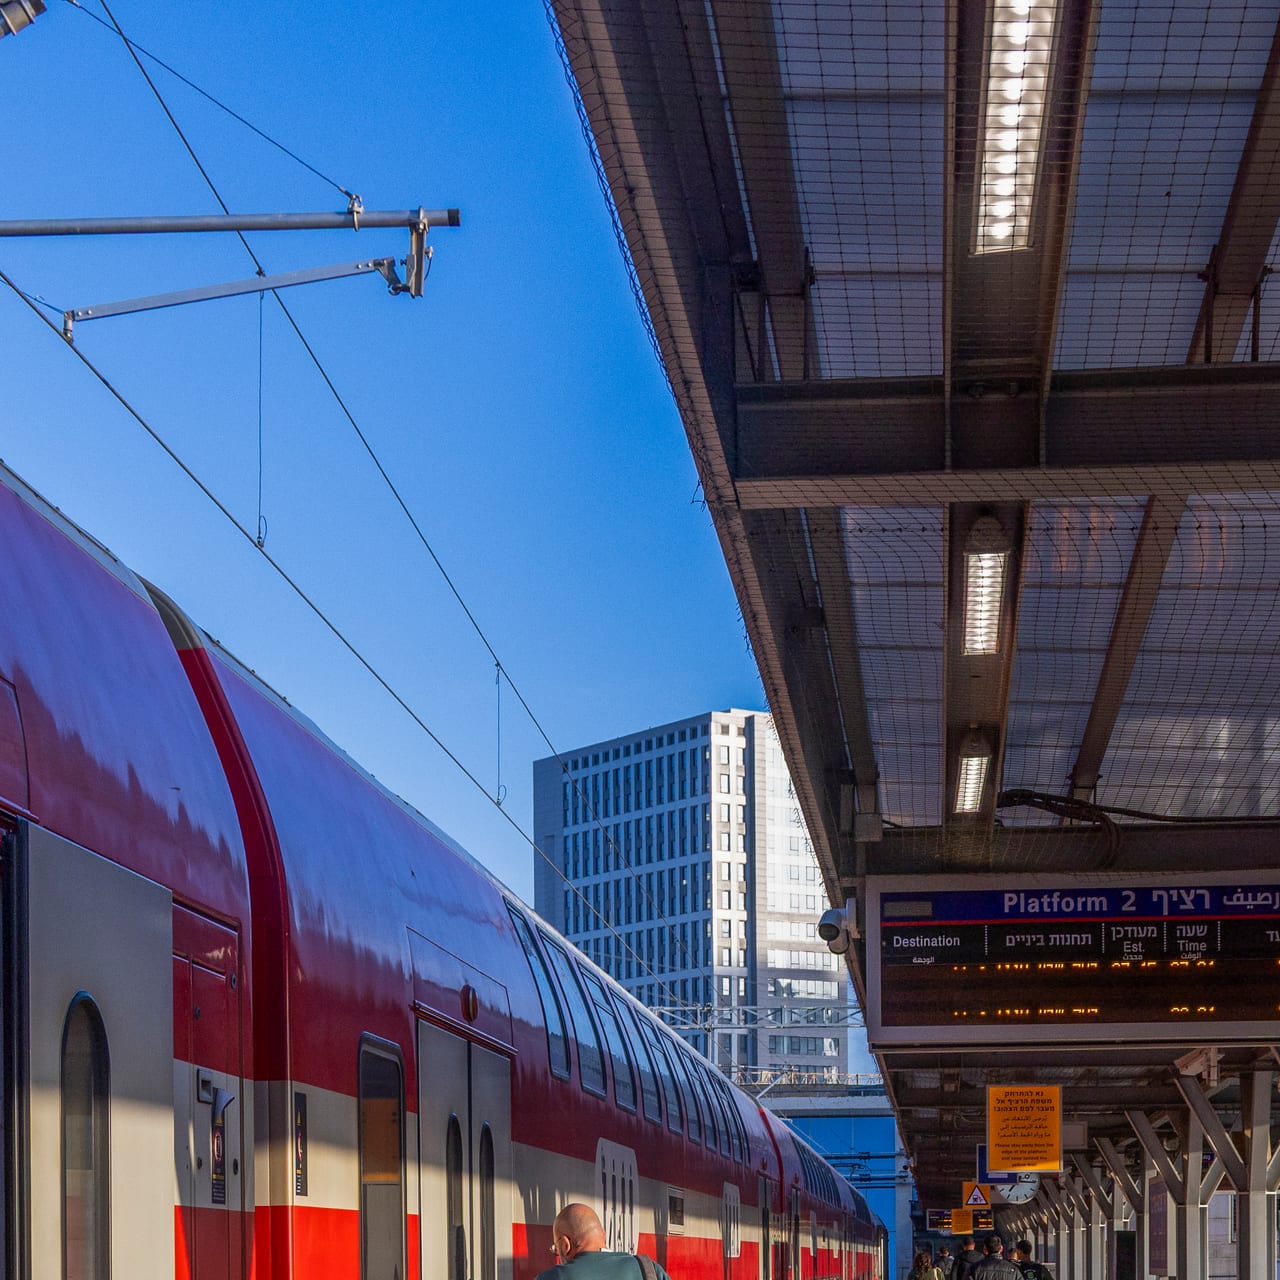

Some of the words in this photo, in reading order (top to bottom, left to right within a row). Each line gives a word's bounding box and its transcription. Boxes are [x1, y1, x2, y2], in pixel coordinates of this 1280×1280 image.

[1004, 892, 1108, 914] Platform
[1122, 890, 1136, 912] 2
[1152, 889, 1211, 916] רציף
[1223, 888, 1280, 910] رصيف
[1110, 926, 1158, 940] מעודכן
[1176, 925, 1208, 937] שעה
[893, 935, 961, 948] Destination
[1006, 934, 1046, 946] ביניים
[1048, 934, 1092, 946] תחנות
[1178, 940, 1207, 951] Time
[1124, 942, 1146, 952] Est.
